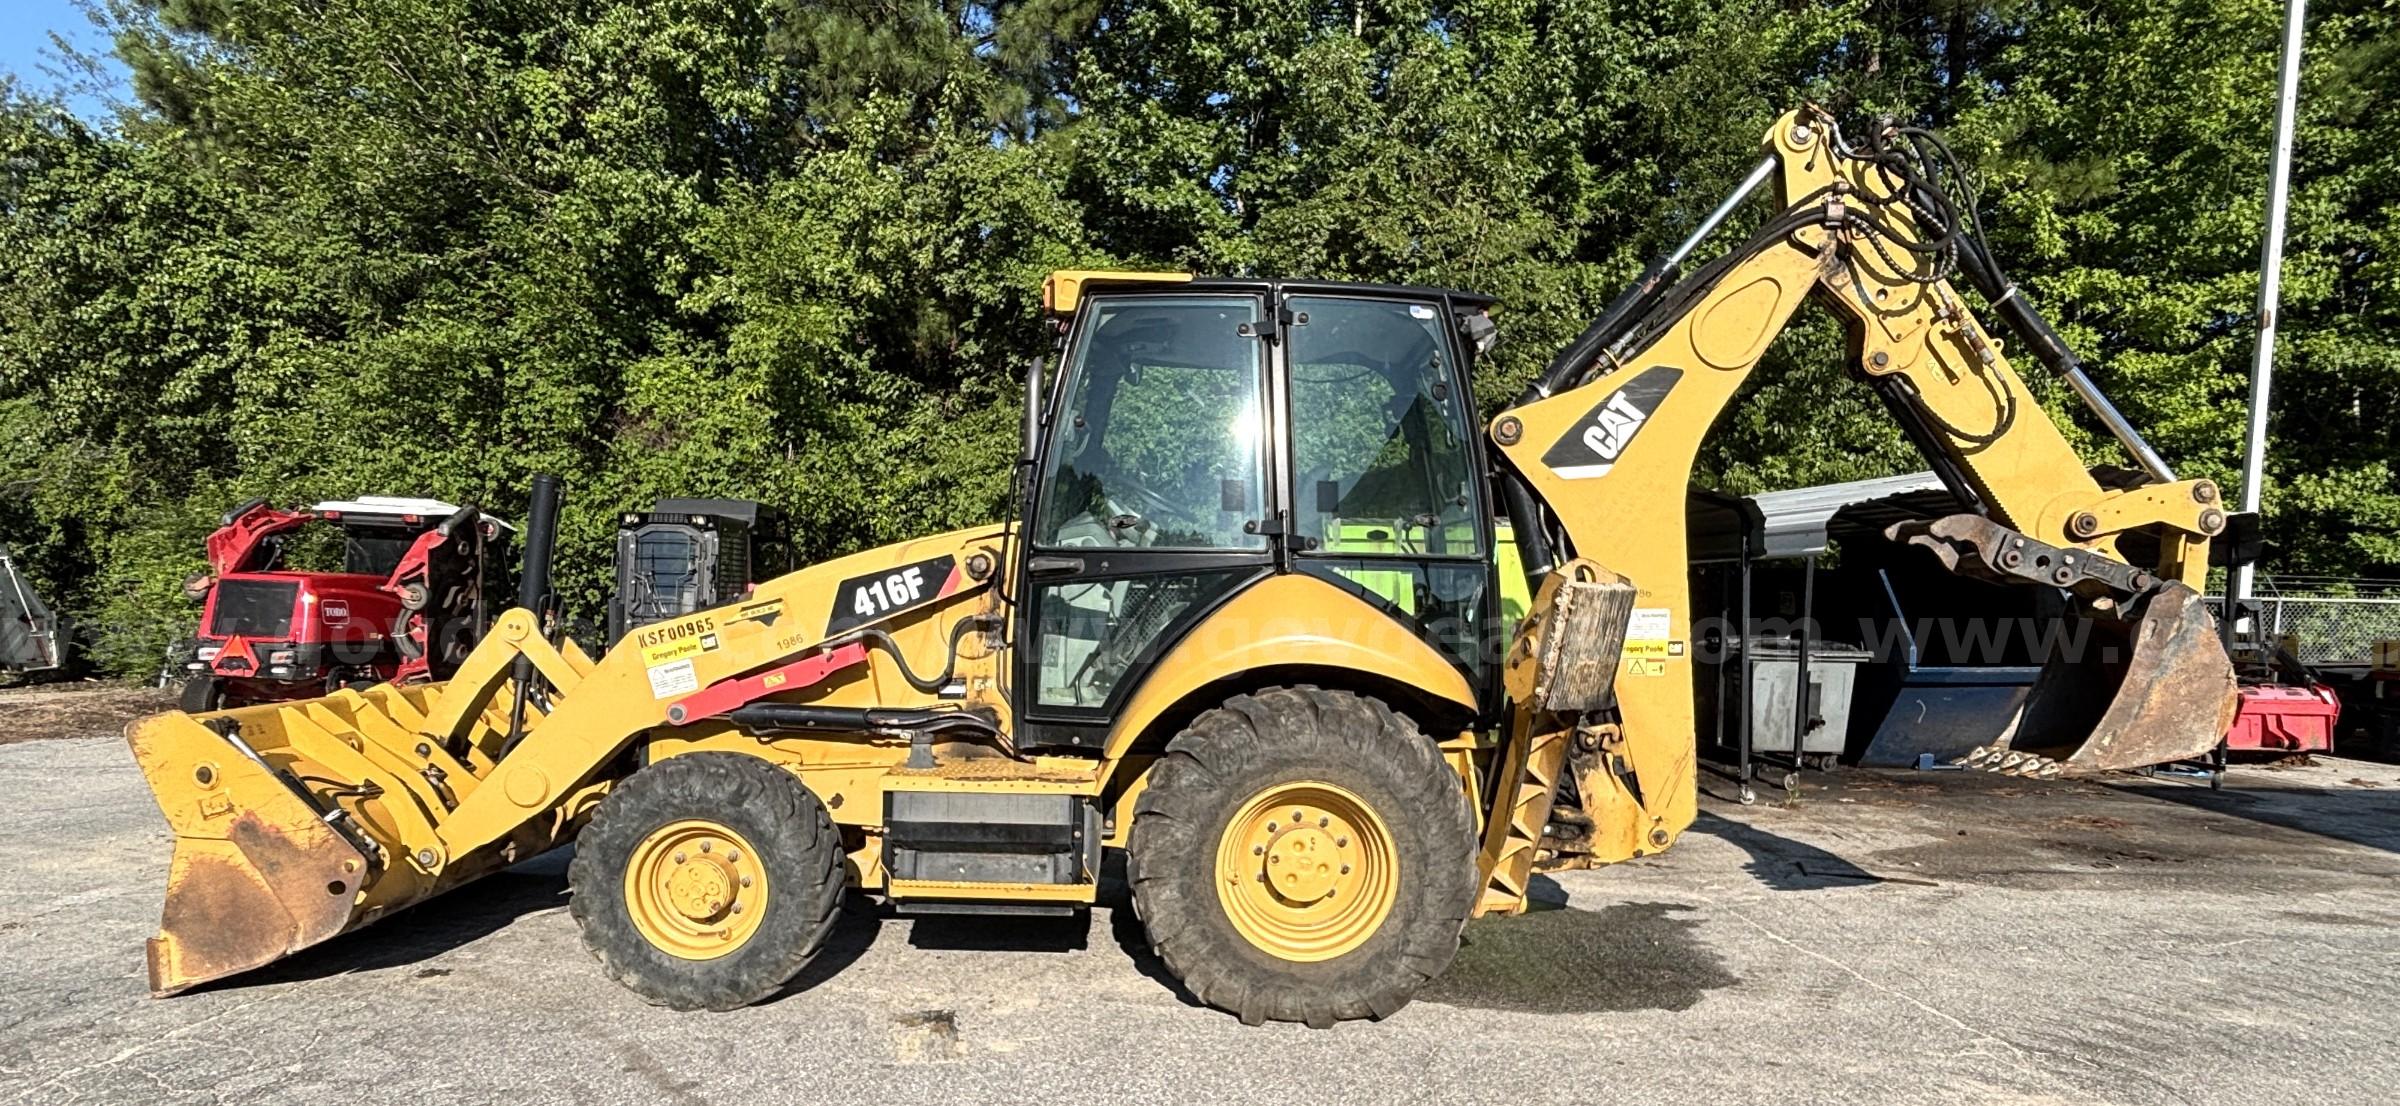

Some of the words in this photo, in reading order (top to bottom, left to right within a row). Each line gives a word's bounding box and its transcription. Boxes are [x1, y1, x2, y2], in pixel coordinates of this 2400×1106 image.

[1583, 390, 1647, 460] CAT
[853, 566, 925, 617] 416F
[324, 607, 347, 617] TORO
[638, 617, 715, 648] KSF00965
[776, 633, 804, 650] 1986
[652, 648, 678, 660] Gregory
[1623, 646, 1644, 655] regory
